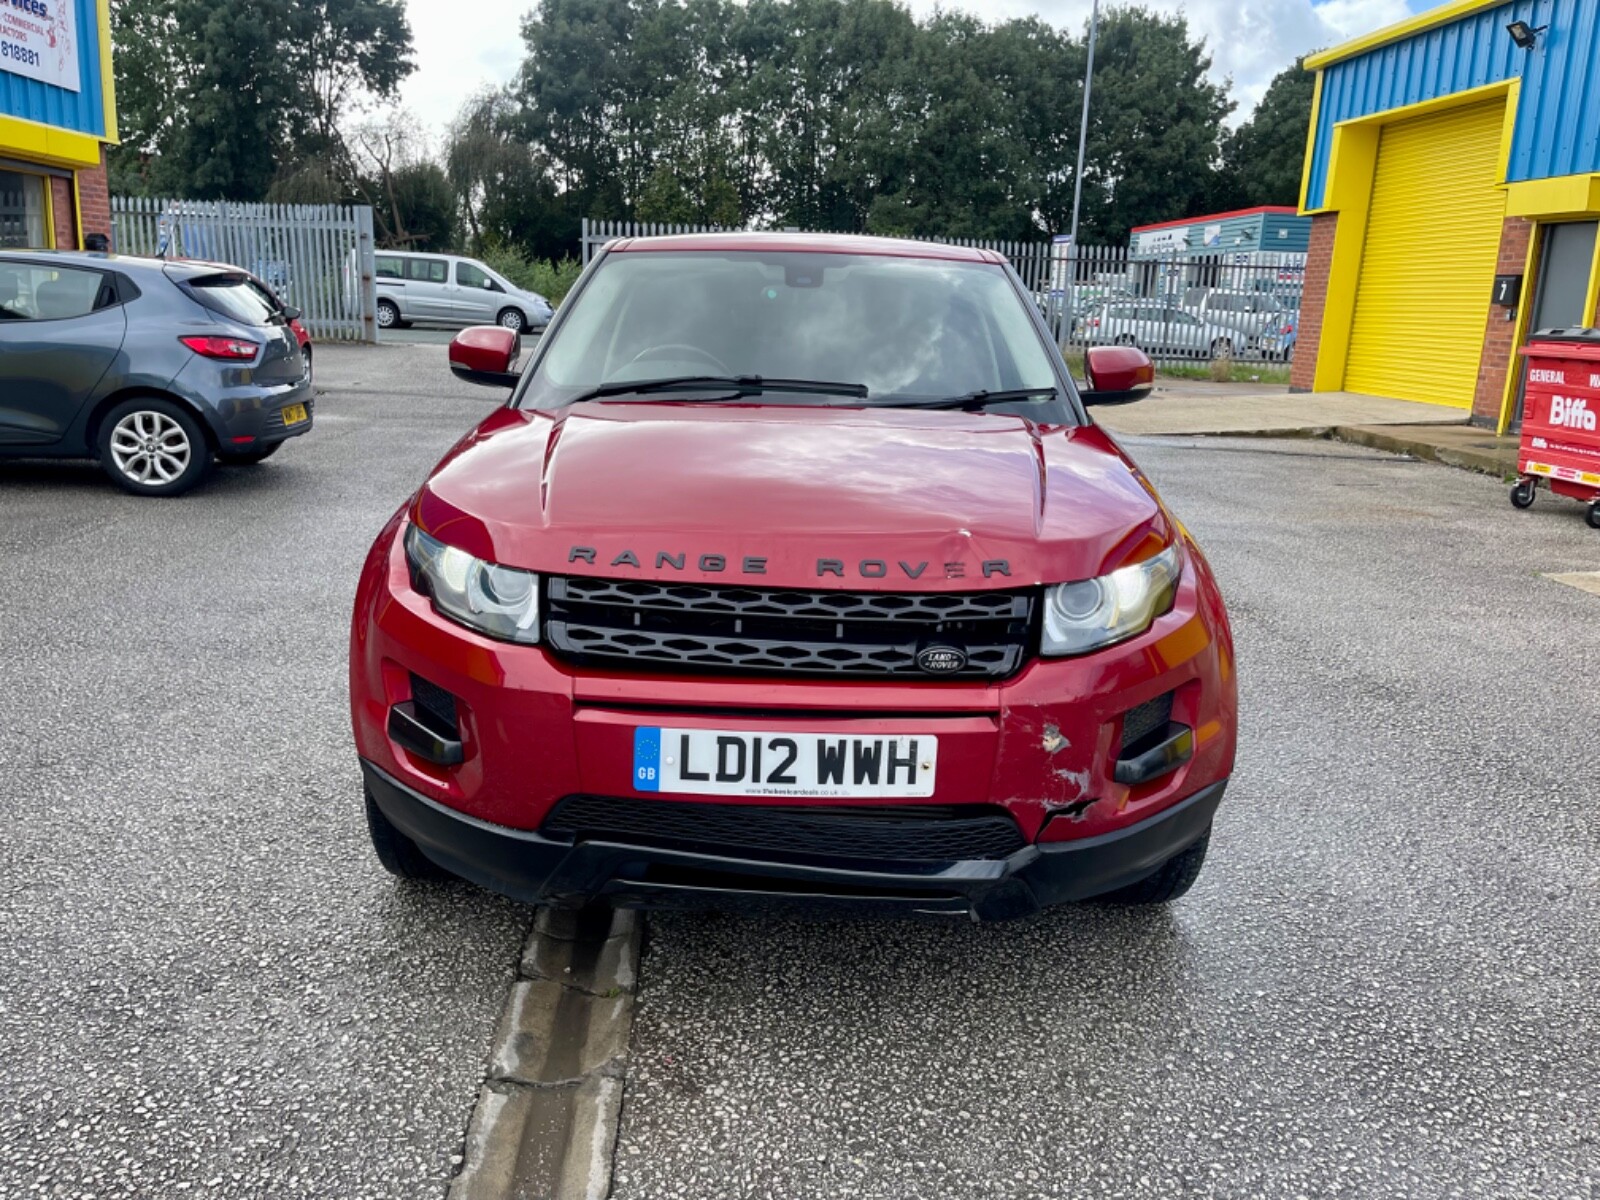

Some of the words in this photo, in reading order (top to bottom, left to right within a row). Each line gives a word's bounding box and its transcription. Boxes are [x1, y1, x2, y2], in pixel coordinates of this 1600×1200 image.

[1, 40, 40, 67] 818881
[1499, 283, 1507, 301] 7
[1530, 369, 1565, 384] GENERAL
[1549, 395, 1596, 431] Biffa
[568, 546, 767, 574] RANGE
[816, 558, 1012, 580] ROVER
[928, 653, 952, 661] LAND
[930, 661, 958, 669] ROVER
[680, 734, 797, 784] LD12
[817, 739, 918, 785] WWH
[638, 767, 655, 780] GB
